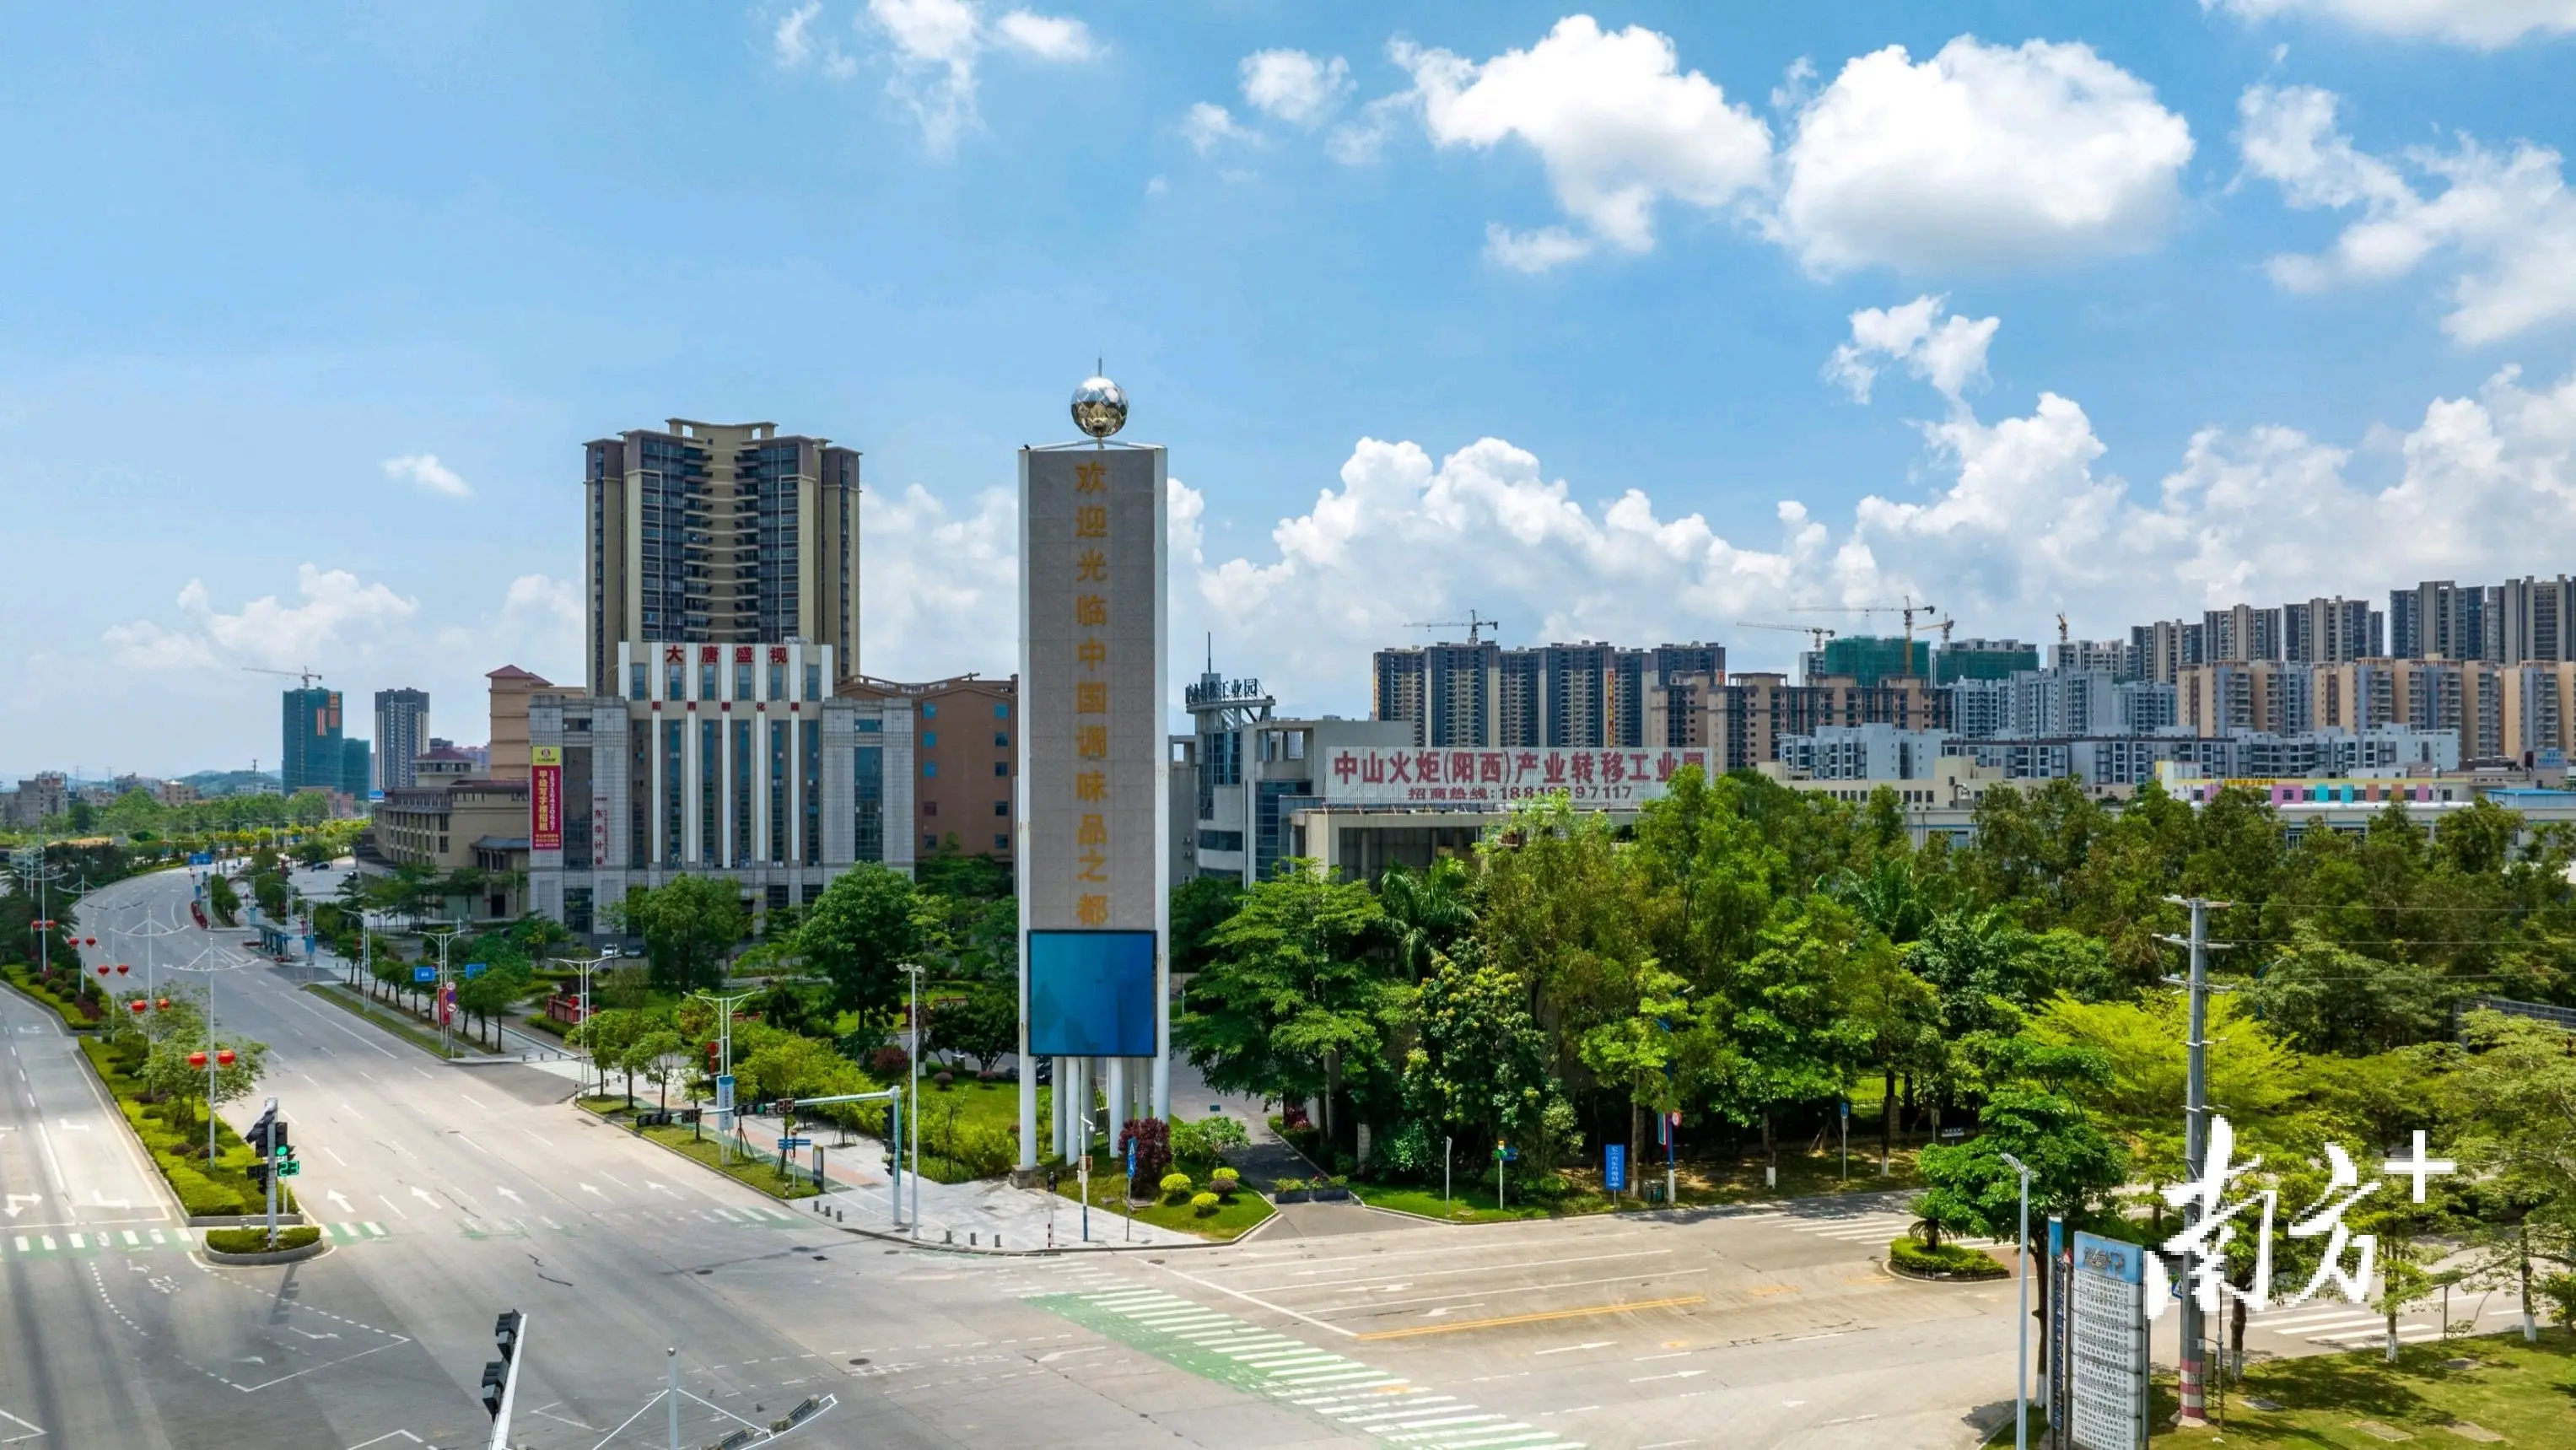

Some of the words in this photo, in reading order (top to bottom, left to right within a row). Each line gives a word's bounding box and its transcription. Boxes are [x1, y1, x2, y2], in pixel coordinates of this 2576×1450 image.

[666, 644, 788, 664] 大唐盛视
[1075, 460, 1108, 927] 欢迎光临中国调味品之都
[279, 1161, 299, 1177] 23
